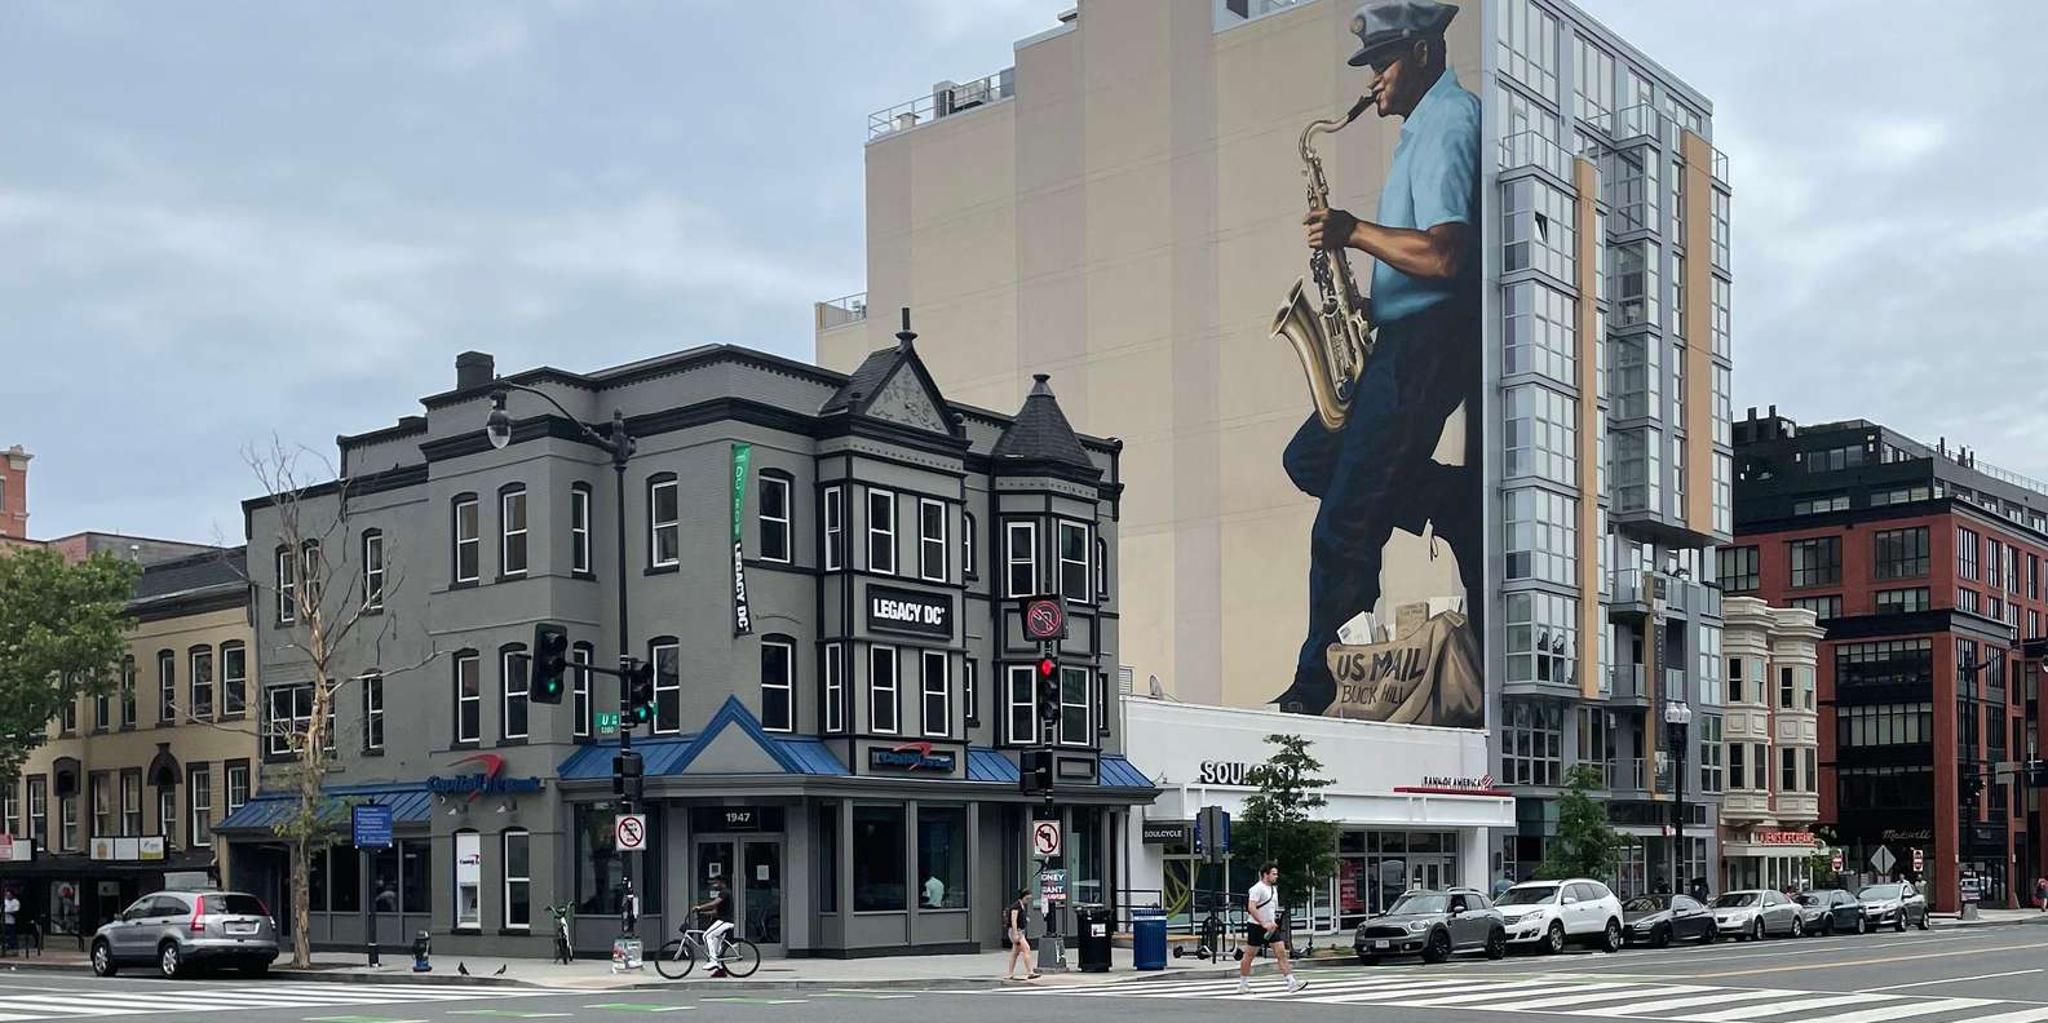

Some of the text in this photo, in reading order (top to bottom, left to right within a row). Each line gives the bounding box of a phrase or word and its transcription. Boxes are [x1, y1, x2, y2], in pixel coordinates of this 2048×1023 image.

[734, 543, 745, 601] LEGACY
[737, 606, 749, 628] DC
[873, 598, 943, 625] LEGACY DC
[1337, 648, 1424, 682] US MAIL
[1341, 683, 1405, 704] BUCK HILL
[602, 714, 609, 726] U
[725, 812, 751, 823] 1947
[1144, 830, 1183, 838] SOULCYCLE
